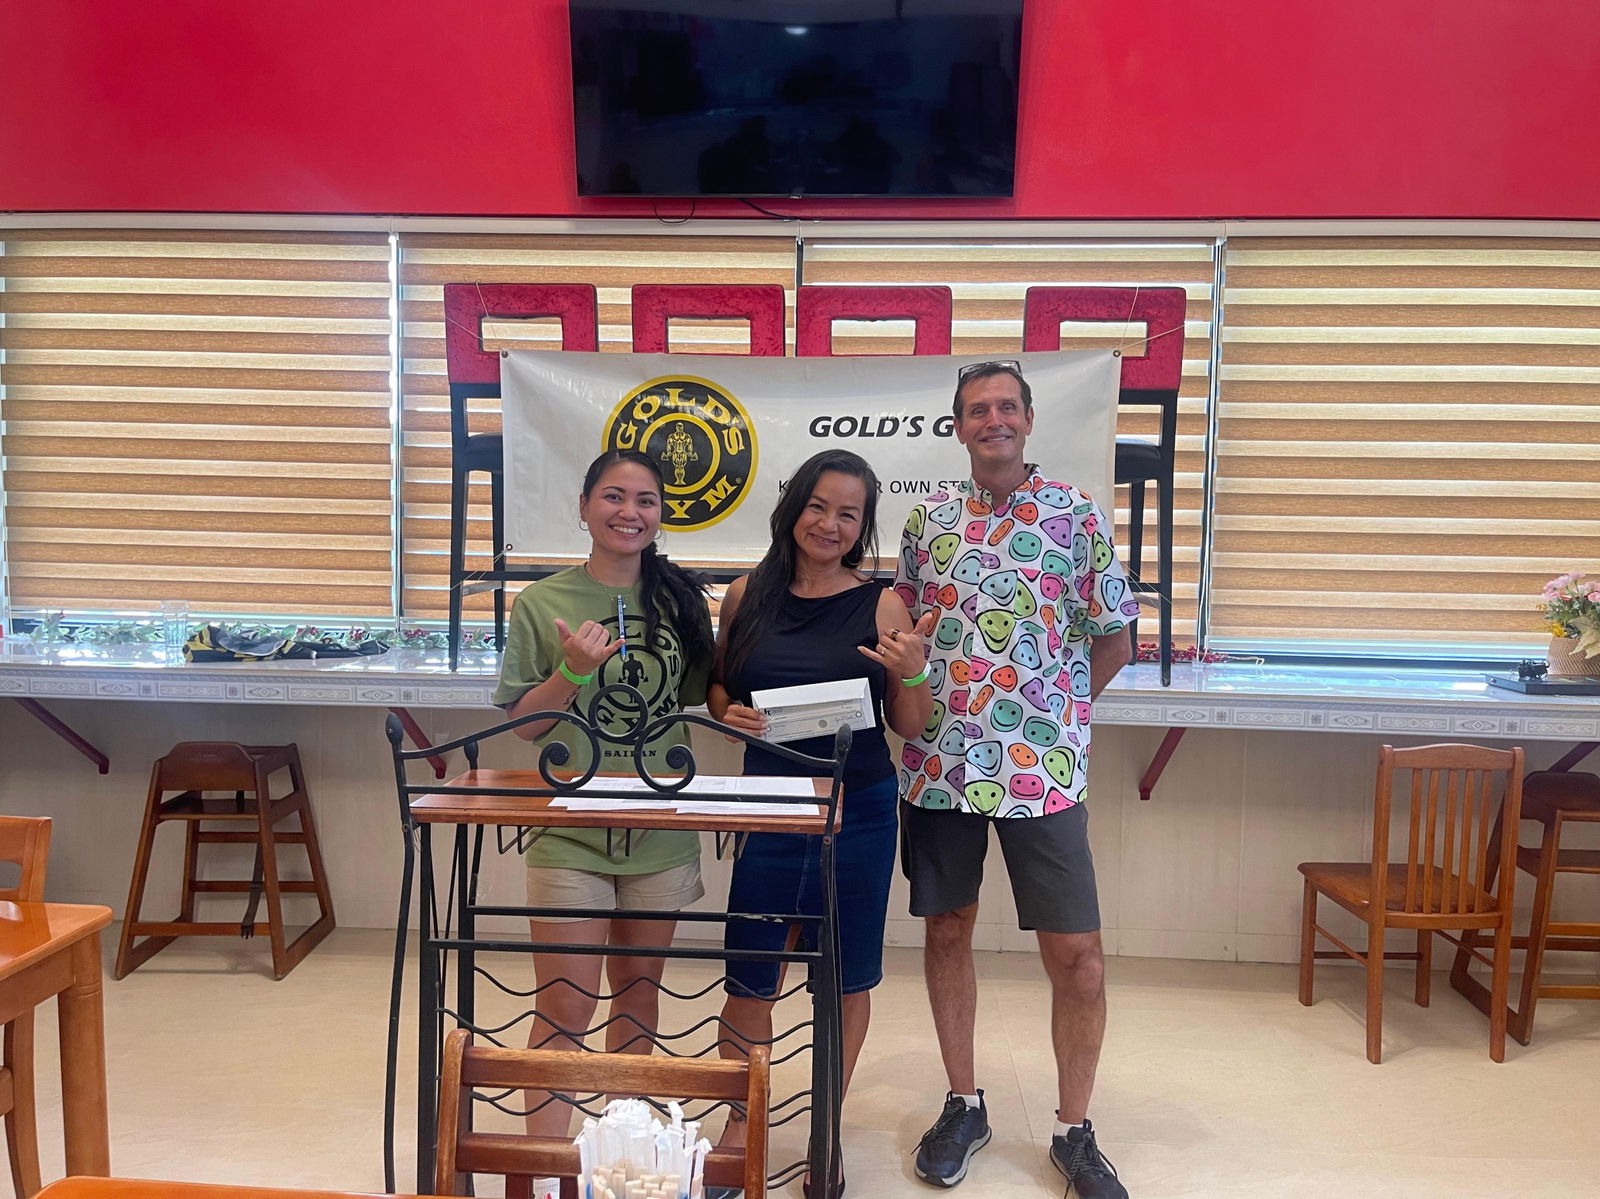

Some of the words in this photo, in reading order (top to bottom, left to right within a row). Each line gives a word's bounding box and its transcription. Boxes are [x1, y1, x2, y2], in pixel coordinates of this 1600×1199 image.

[616, 388, 745, 456] GOLD'S
[809, 416, 925, 438] GOLD'S
[664, 474, 738, 518] YM
[889, 480, 931, 494] OWN
